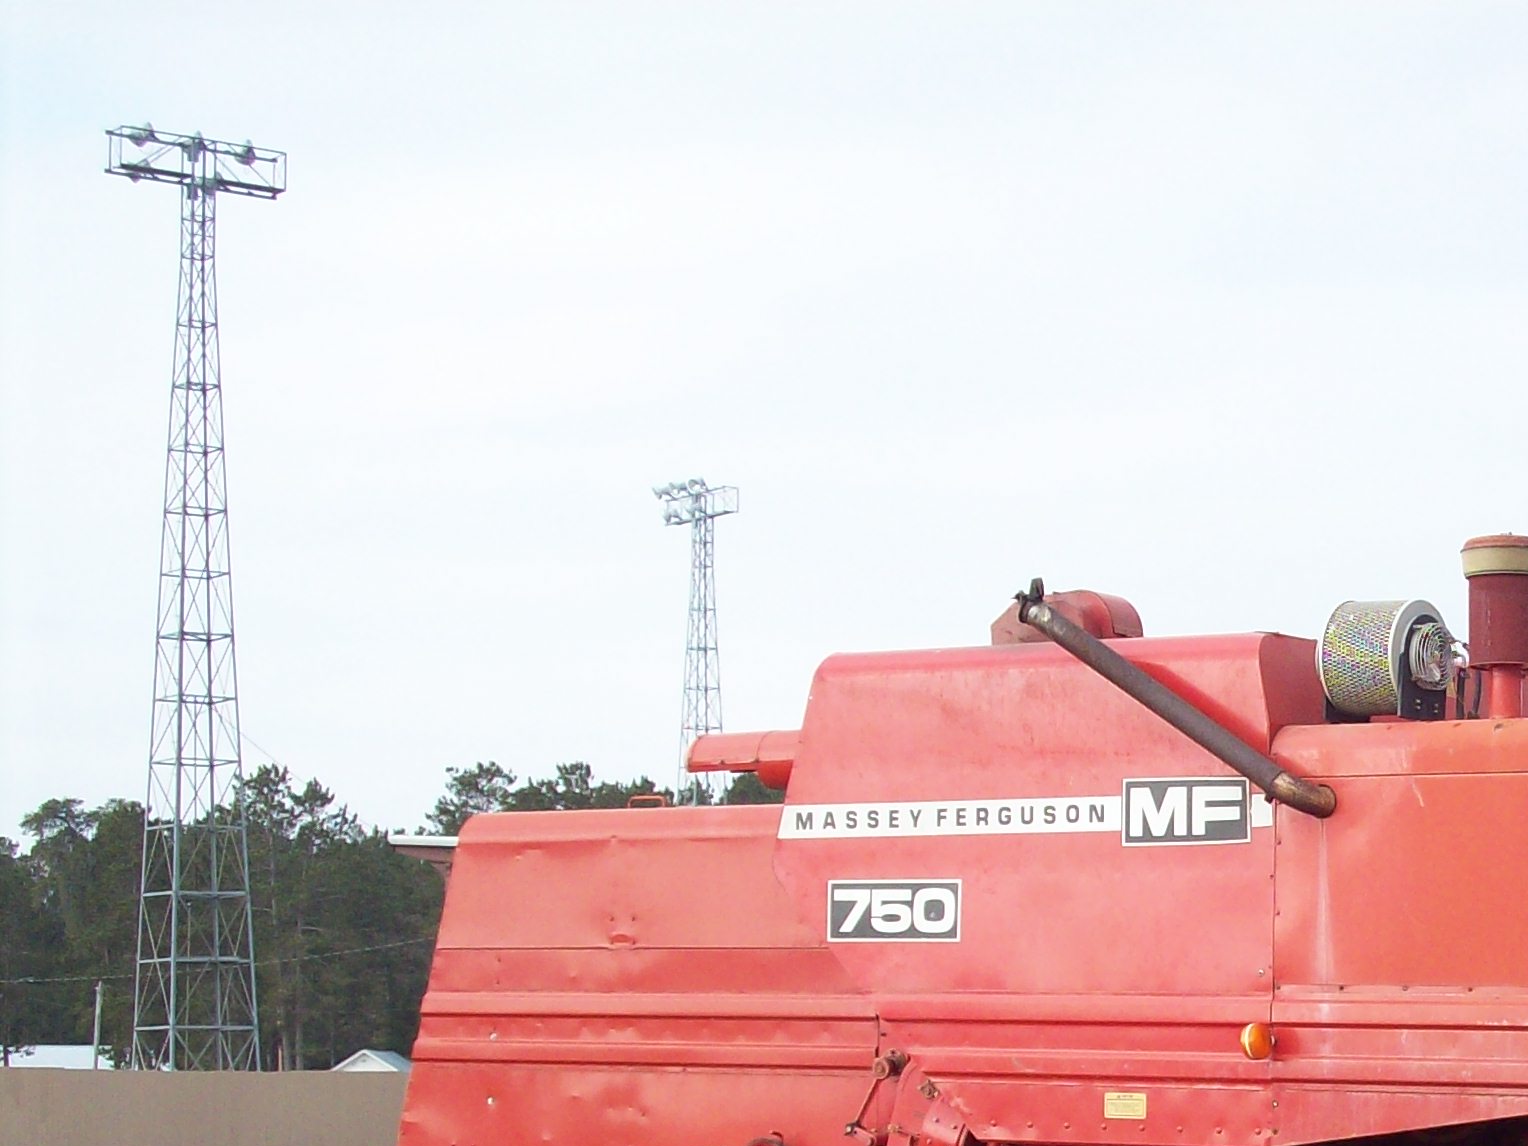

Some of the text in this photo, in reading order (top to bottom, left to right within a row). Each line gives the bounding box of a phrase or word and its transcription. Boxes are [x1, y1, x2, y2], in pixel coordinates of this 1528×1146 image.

[795, 785, 1242, 837] MASSEY FERGUSON MF
[833, 887, 956, 934] 750
